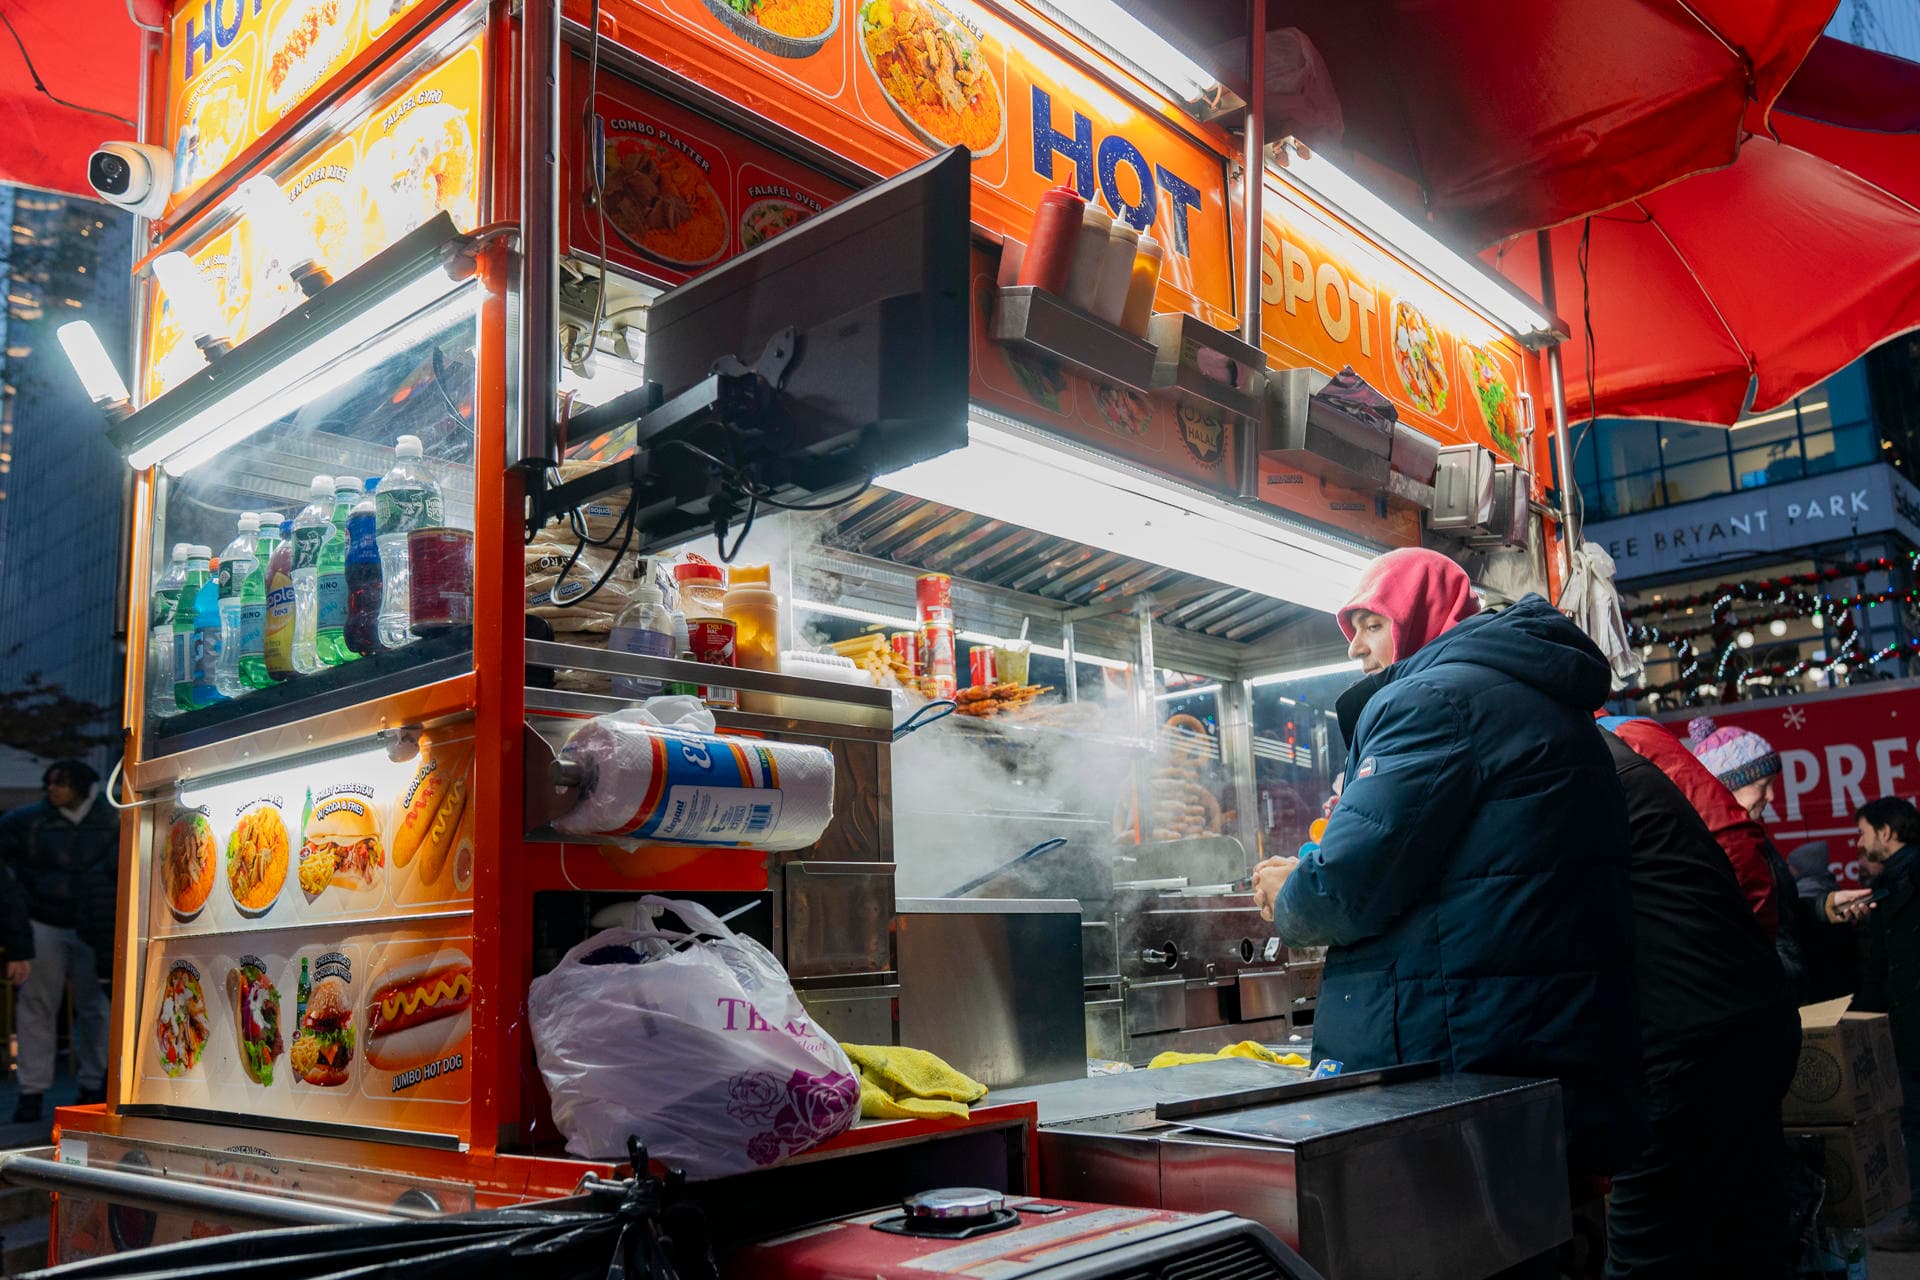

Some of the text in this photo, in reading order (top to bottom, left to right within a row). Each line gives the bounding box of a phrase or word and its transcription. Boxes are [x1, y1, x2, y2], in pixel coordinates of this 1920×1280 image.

[383, 89, 443, 133] FALAFEL GYRO
[610, 119, 712, 173] COMBO PLATTER
[303, 166, 326, 189] OVER
[327, 164, 348, 182] RICE
[1031, 83, 1202, 258] HOT
[748, 185, 824, 214] FALAFEL OVER
[1262, 223, 1376, 358] SPOT
[1188, 426, 1216, 448] HALAL
[1609, 537, 1640, 560] EE
[1654, 510, 1769, 551] BRYANT
[1788, 490, 1869, 526] PARK
[706, 623, 722, 631] CHILI
[403, 759, 437, 809] CORN DOG
[1762, 736, 1920, 823] PRE
[348, 801, 364, 816] FRIES
[392, 1053, 463, 1092] JUMBO HOT DOG
